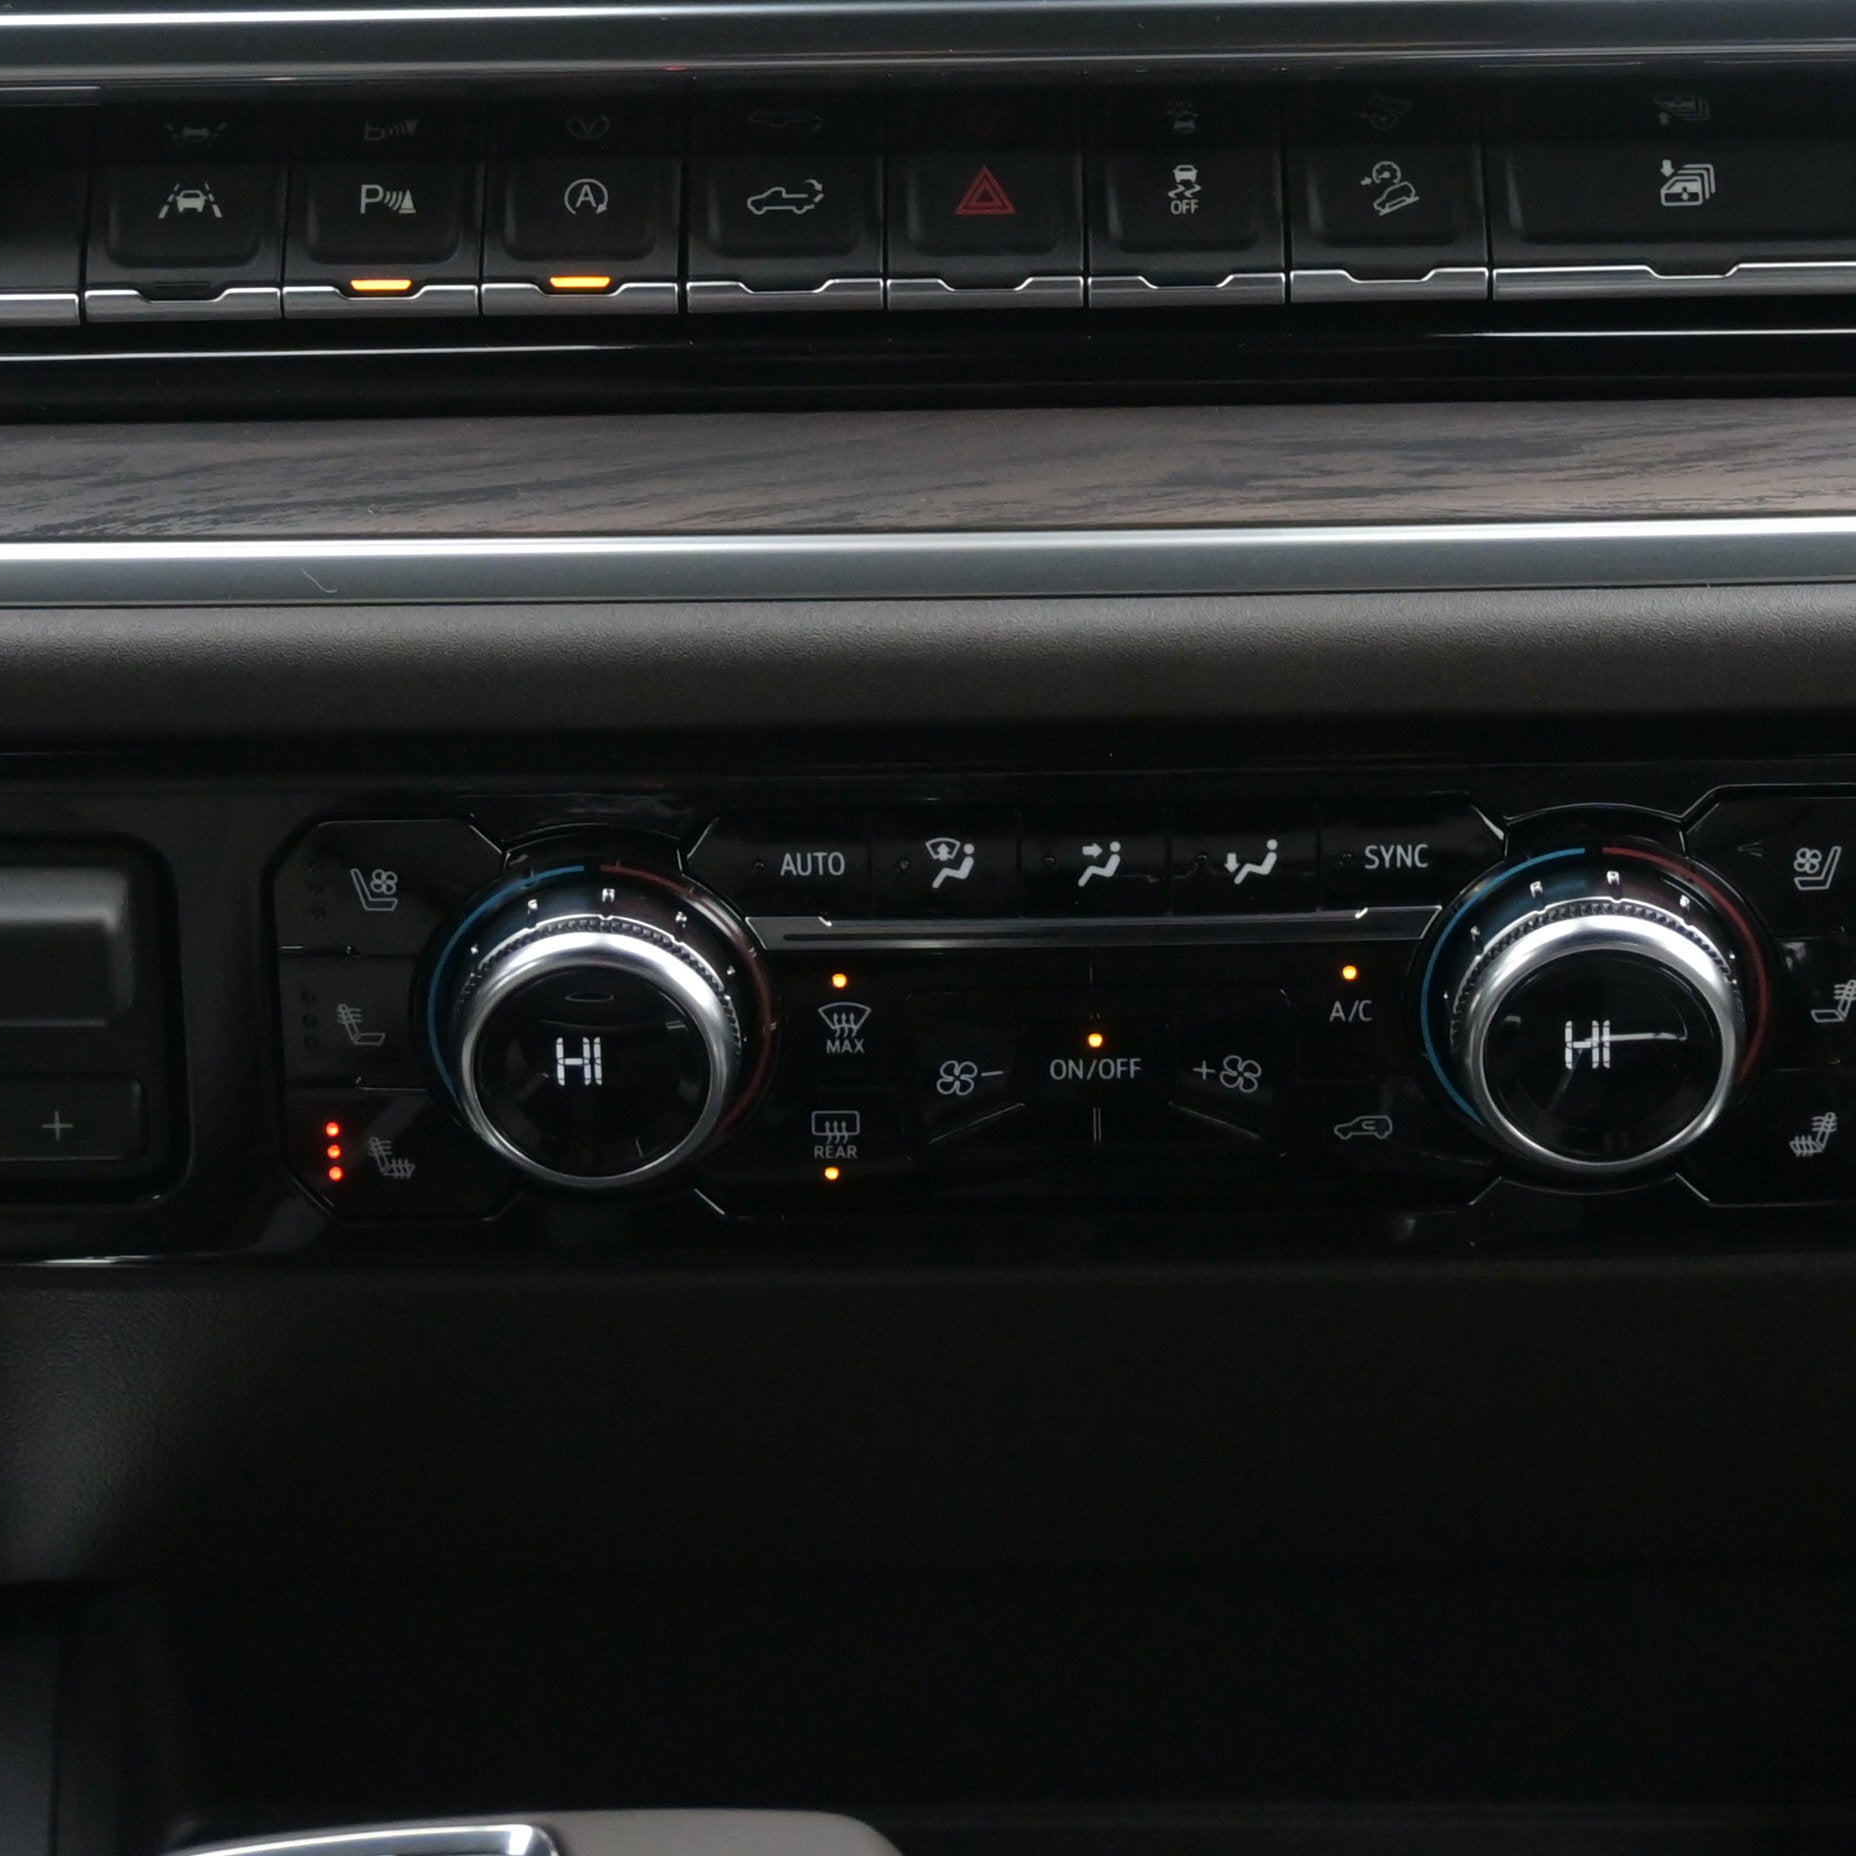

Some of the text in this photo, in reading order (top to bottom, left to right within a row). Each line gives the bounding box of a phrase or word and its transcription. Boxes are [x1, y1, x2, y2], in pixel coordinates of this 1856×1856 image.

[1170, 200, 1199, 214] OFF
[781, 852, 845, 875] AUTO
[1365, 844, 1427, 869] SYNC
[1330, 1000, 1371, 1021] A/C
[827, 1039, 864, 1053] MAX
[1050, 1058, 1141, 1080] ON/OFF
[814, 1141, 857, 1158] REAR
